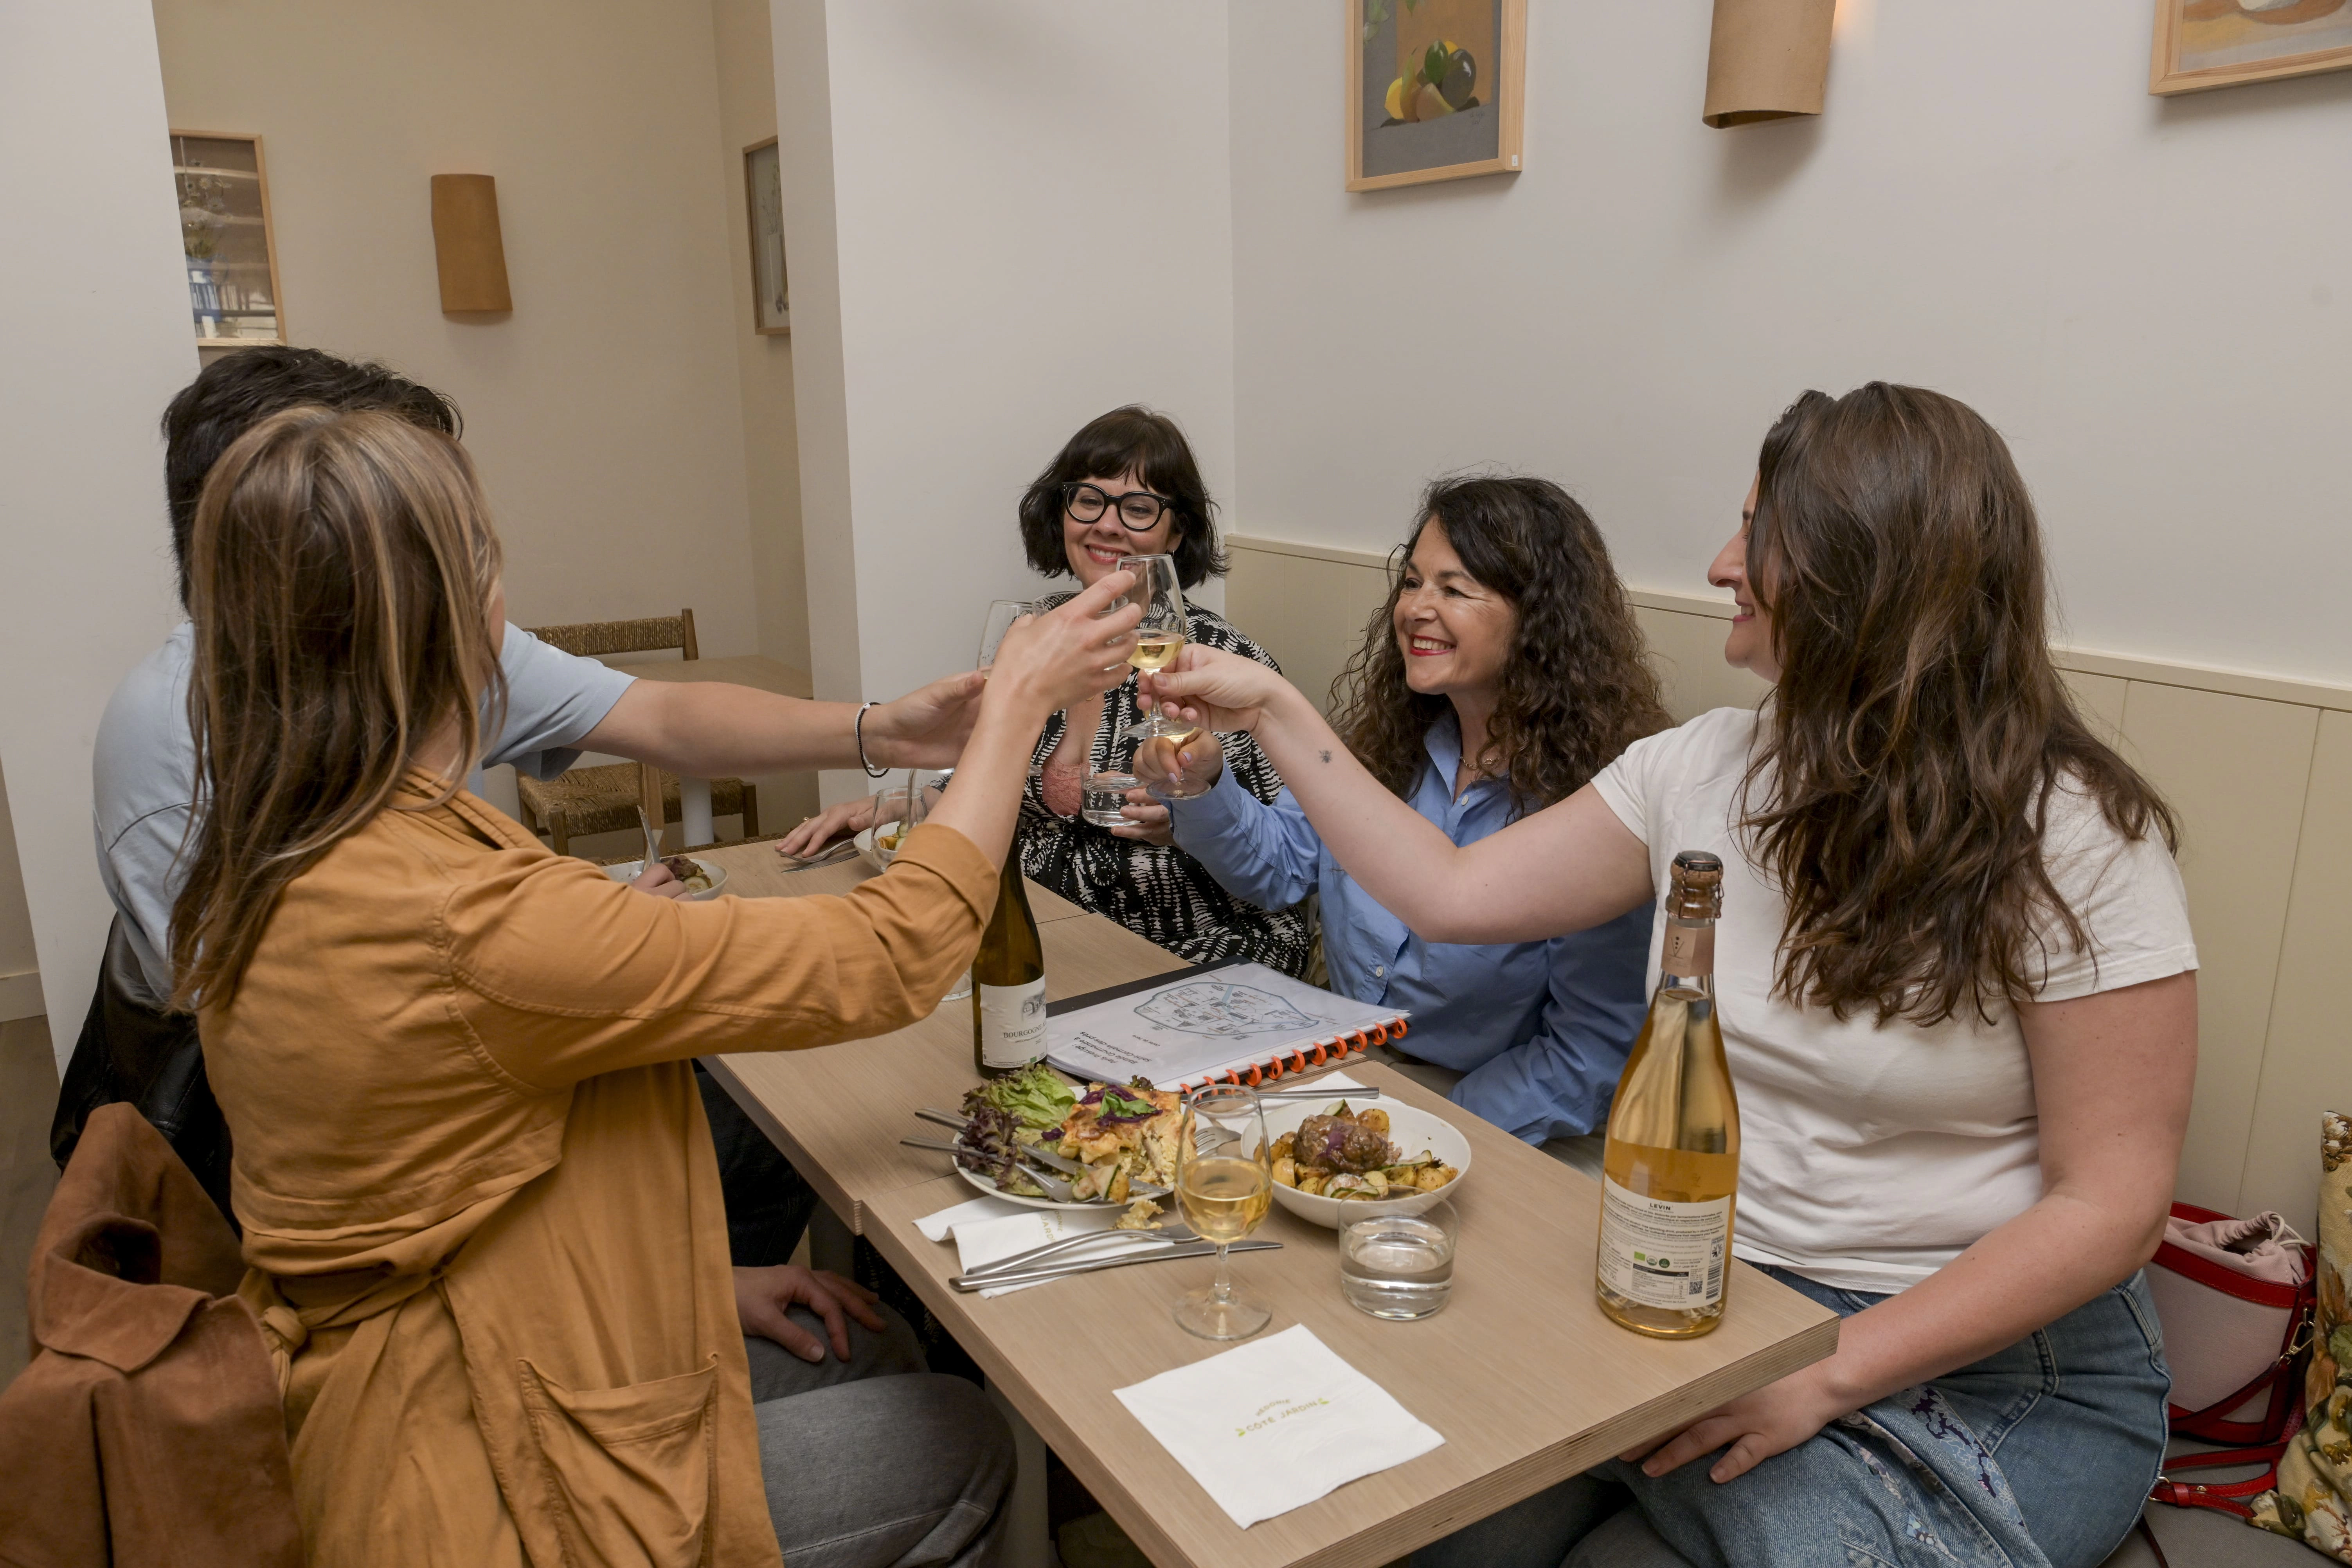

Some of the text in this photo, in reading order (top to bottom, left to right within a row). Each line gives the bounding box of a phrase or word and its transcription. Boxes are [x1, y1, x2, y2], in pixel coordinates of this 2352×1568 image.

[1004, 1024, 1042, 1038] BOURGOGNE
[1075, 1045, 1102, 1058] Prestige
[1079, 1039, 1116, 1057] Gourmande
[1115, 1055, 1138, 1064] Balade
[1280, 1400, 1317, 1419] JARDIN
